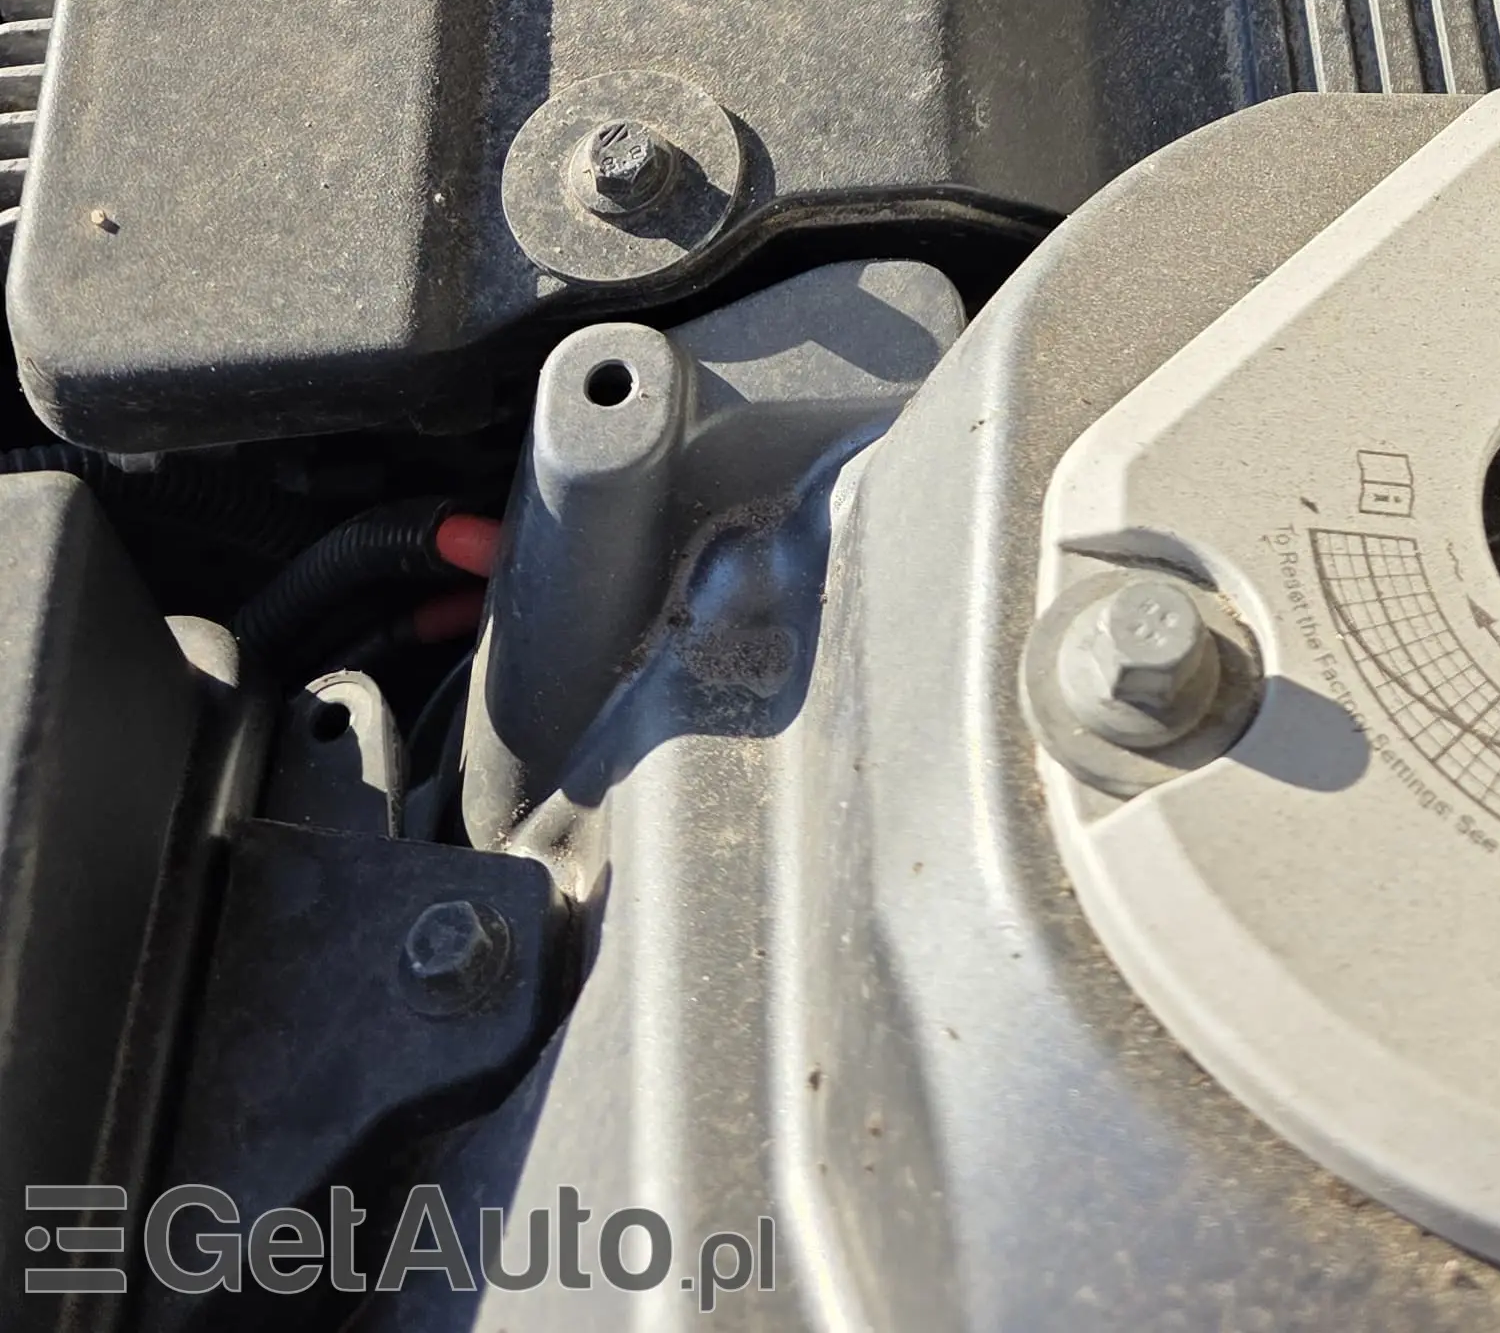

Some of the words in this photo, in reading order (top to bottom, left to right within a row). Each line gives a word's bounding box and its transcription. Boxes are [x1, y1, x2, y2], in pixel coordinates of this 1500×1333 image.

[1279, 549, 1308, 612] Reset
[1296, 612, 1322, 651] the
[1455, 813, 1498, 854] See
